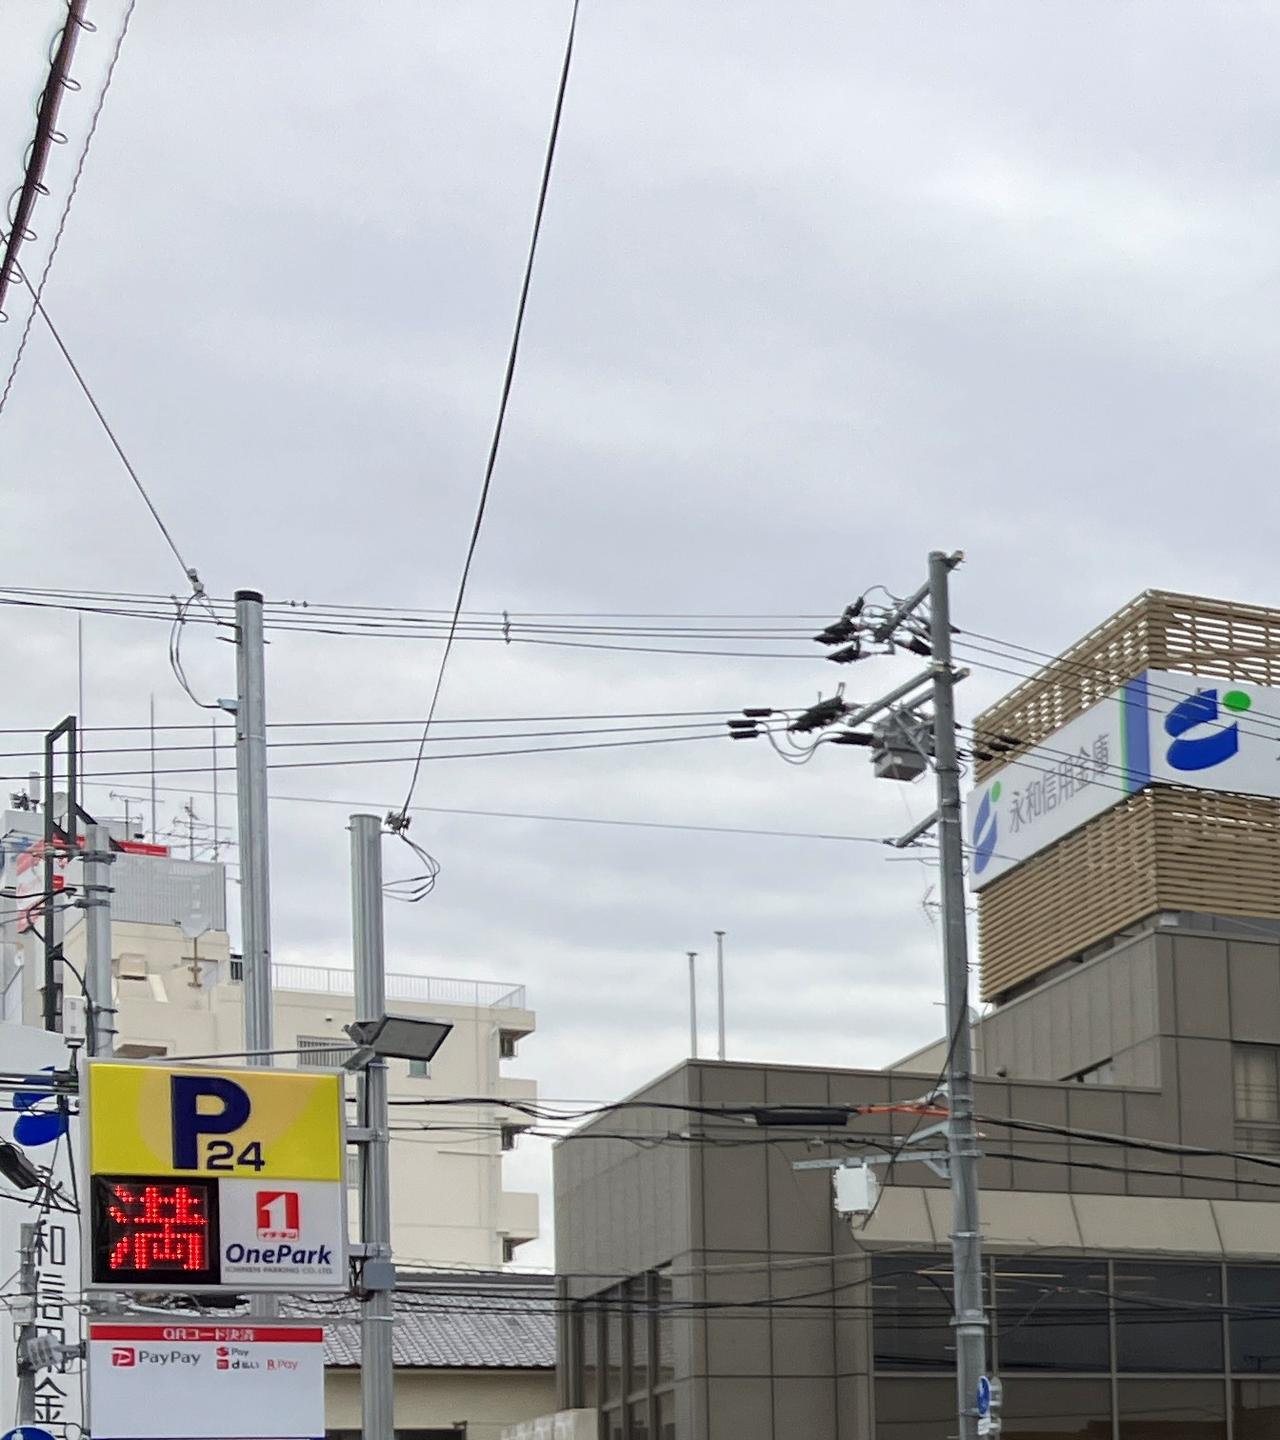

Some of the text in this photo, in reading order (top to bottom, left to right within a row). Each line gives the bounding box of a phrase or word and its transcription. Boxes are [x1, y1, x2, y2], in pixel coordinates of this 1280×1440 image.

[1010, 732, 1109, 834] 永和信用金庫
[170, 1075, 250, 1170] P
[206, 1141, 265, 1171] 24
[108, 1184, 208, 1271] 満
[225, 1243, 332, 1265] OnePark
[163, 1328, 254, 1341] QRコード決済
[139, 1350, 201, 1366] PayPay
